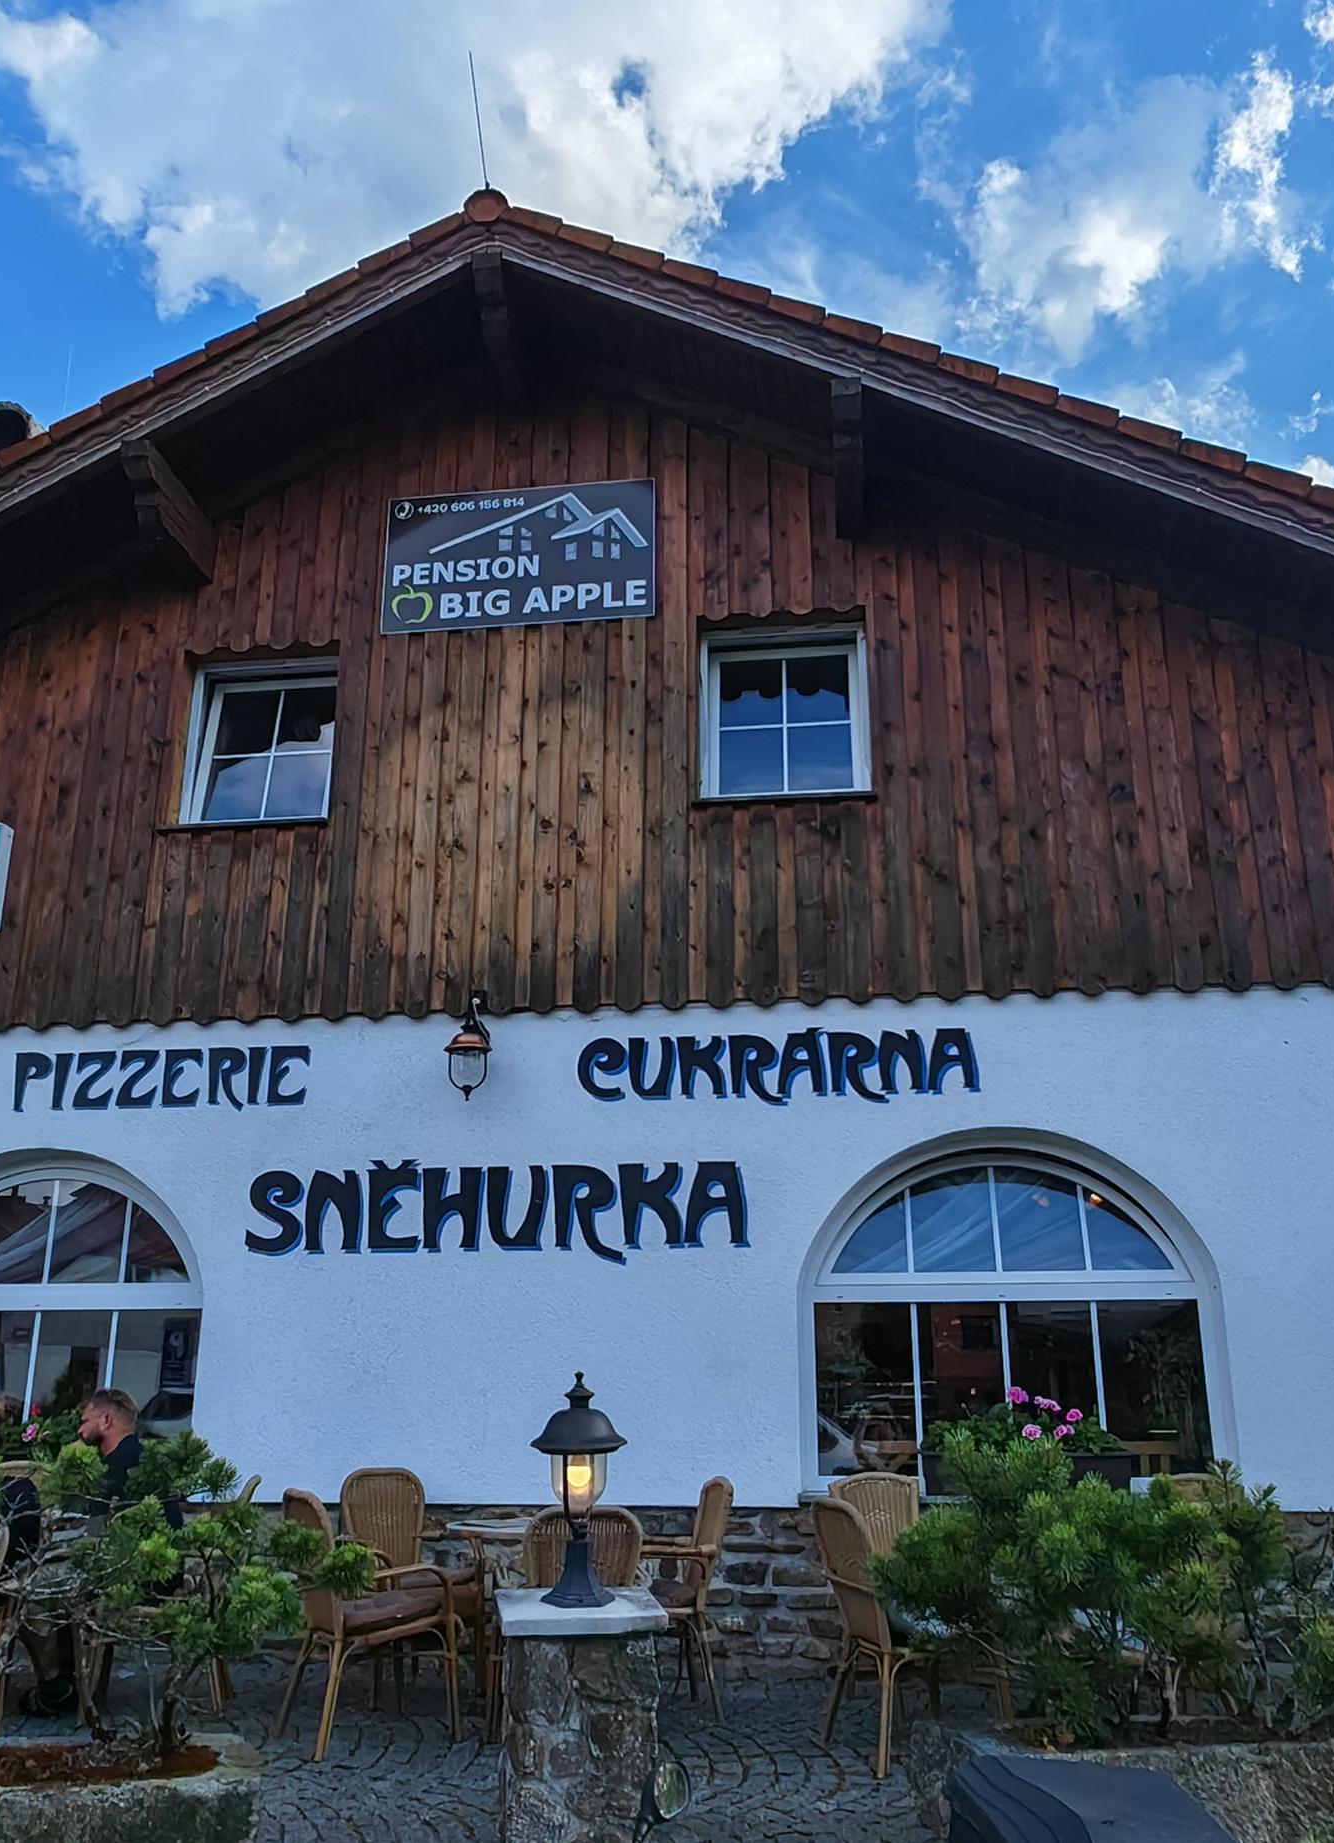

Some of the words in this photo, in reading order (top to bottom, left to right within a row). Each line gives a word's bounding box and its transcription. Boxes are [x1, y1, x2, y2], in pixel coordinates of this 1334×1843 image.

[417, 502, 448, 515] +420
[450, 501, 476, 512] 606
[502, 497, 525, 508] 814
[392, 554, 540, 587] PENSION
[439, 588, 511, 620] BIG
[522, 579, 648, 615] APPLE
[13, 1045, 312, 1112] PIZZERIE
[577, 1026, 982, 1105] CUKRÁRNA
[244, 1158, 752, 1265] SNĚHURKA
